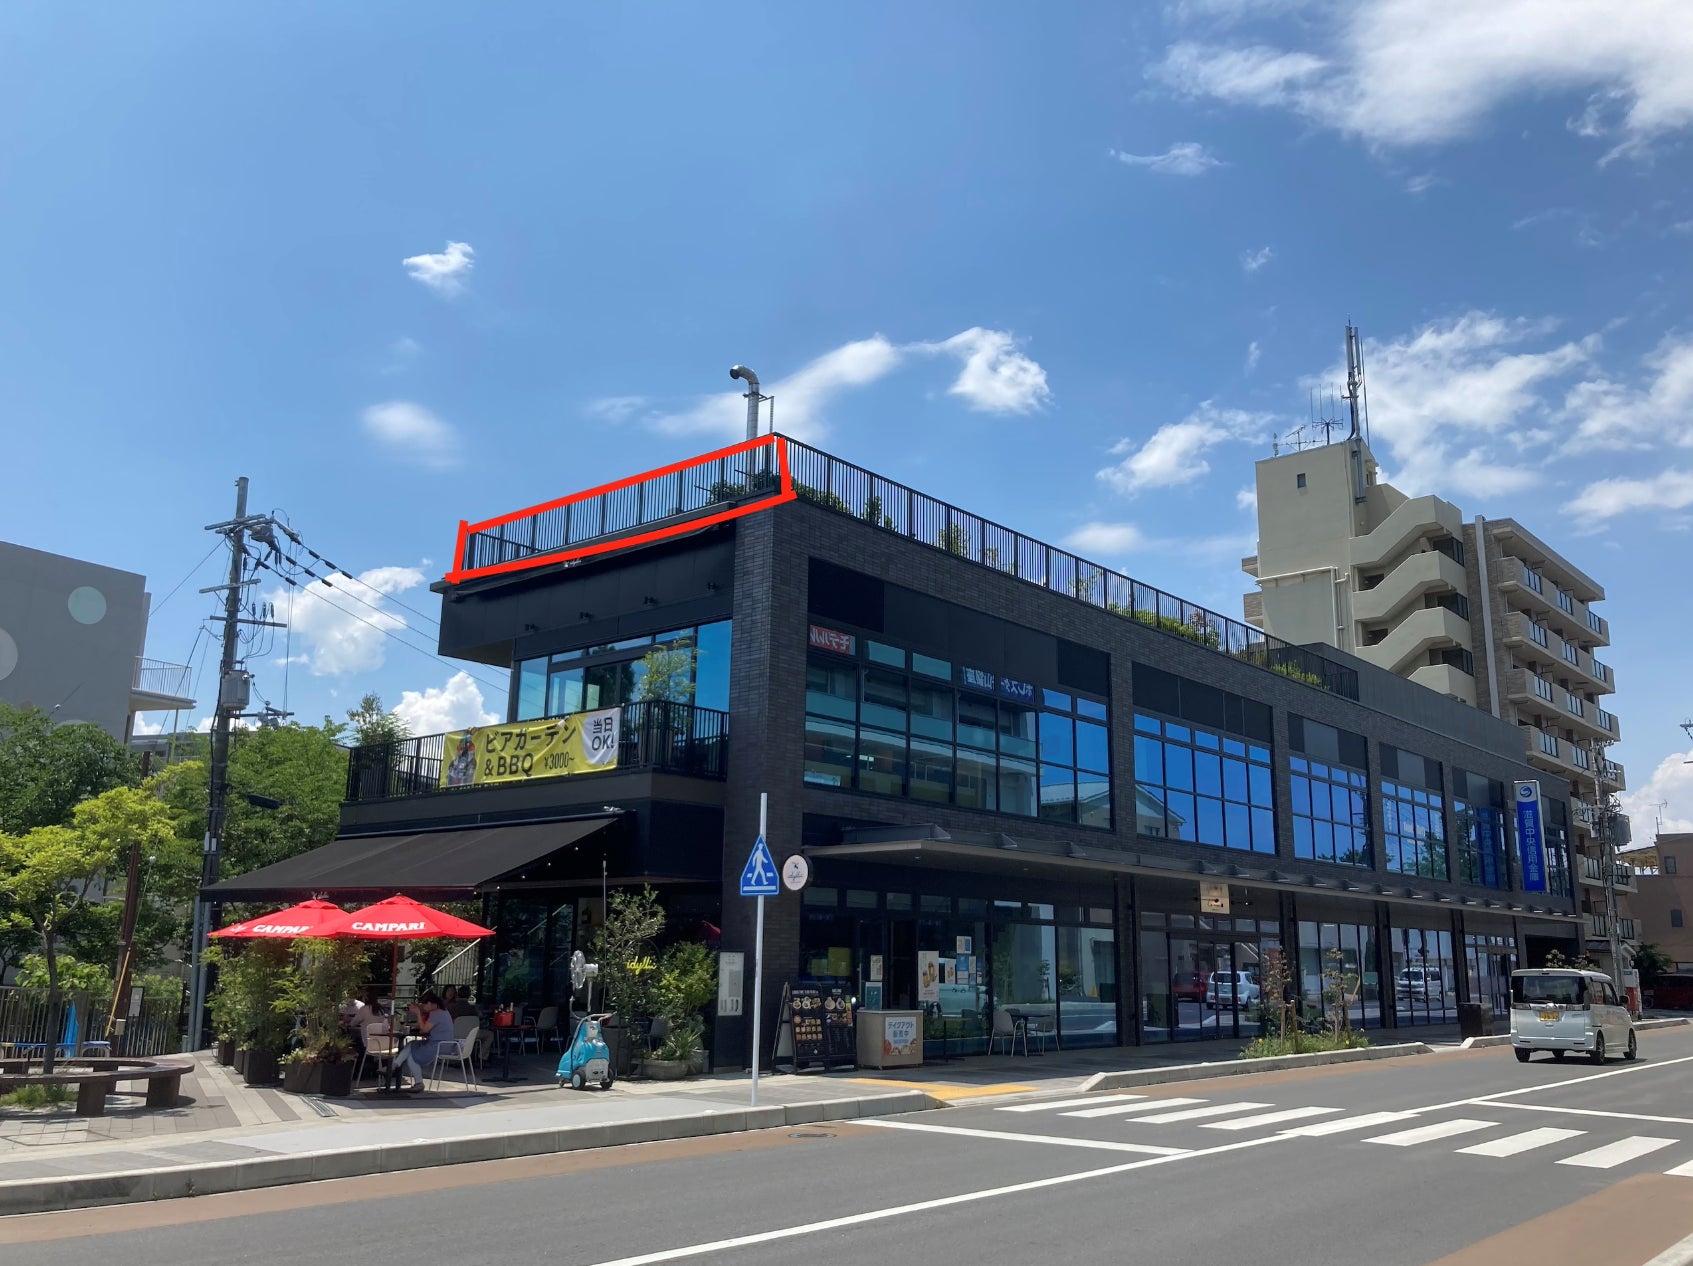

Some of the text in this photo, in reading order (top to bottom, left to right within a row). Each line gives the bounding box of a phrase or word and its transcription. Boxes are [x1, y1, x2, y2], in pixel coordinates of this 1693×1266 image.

[592, 717, 613, 734] 当日
[486, 725, 577, 753] ビアガーデン
[591, 734, 615, 751] OK!
[484, 752, 534, 778] & BBQ
[352, 921, 426, 932] CAMPARI
